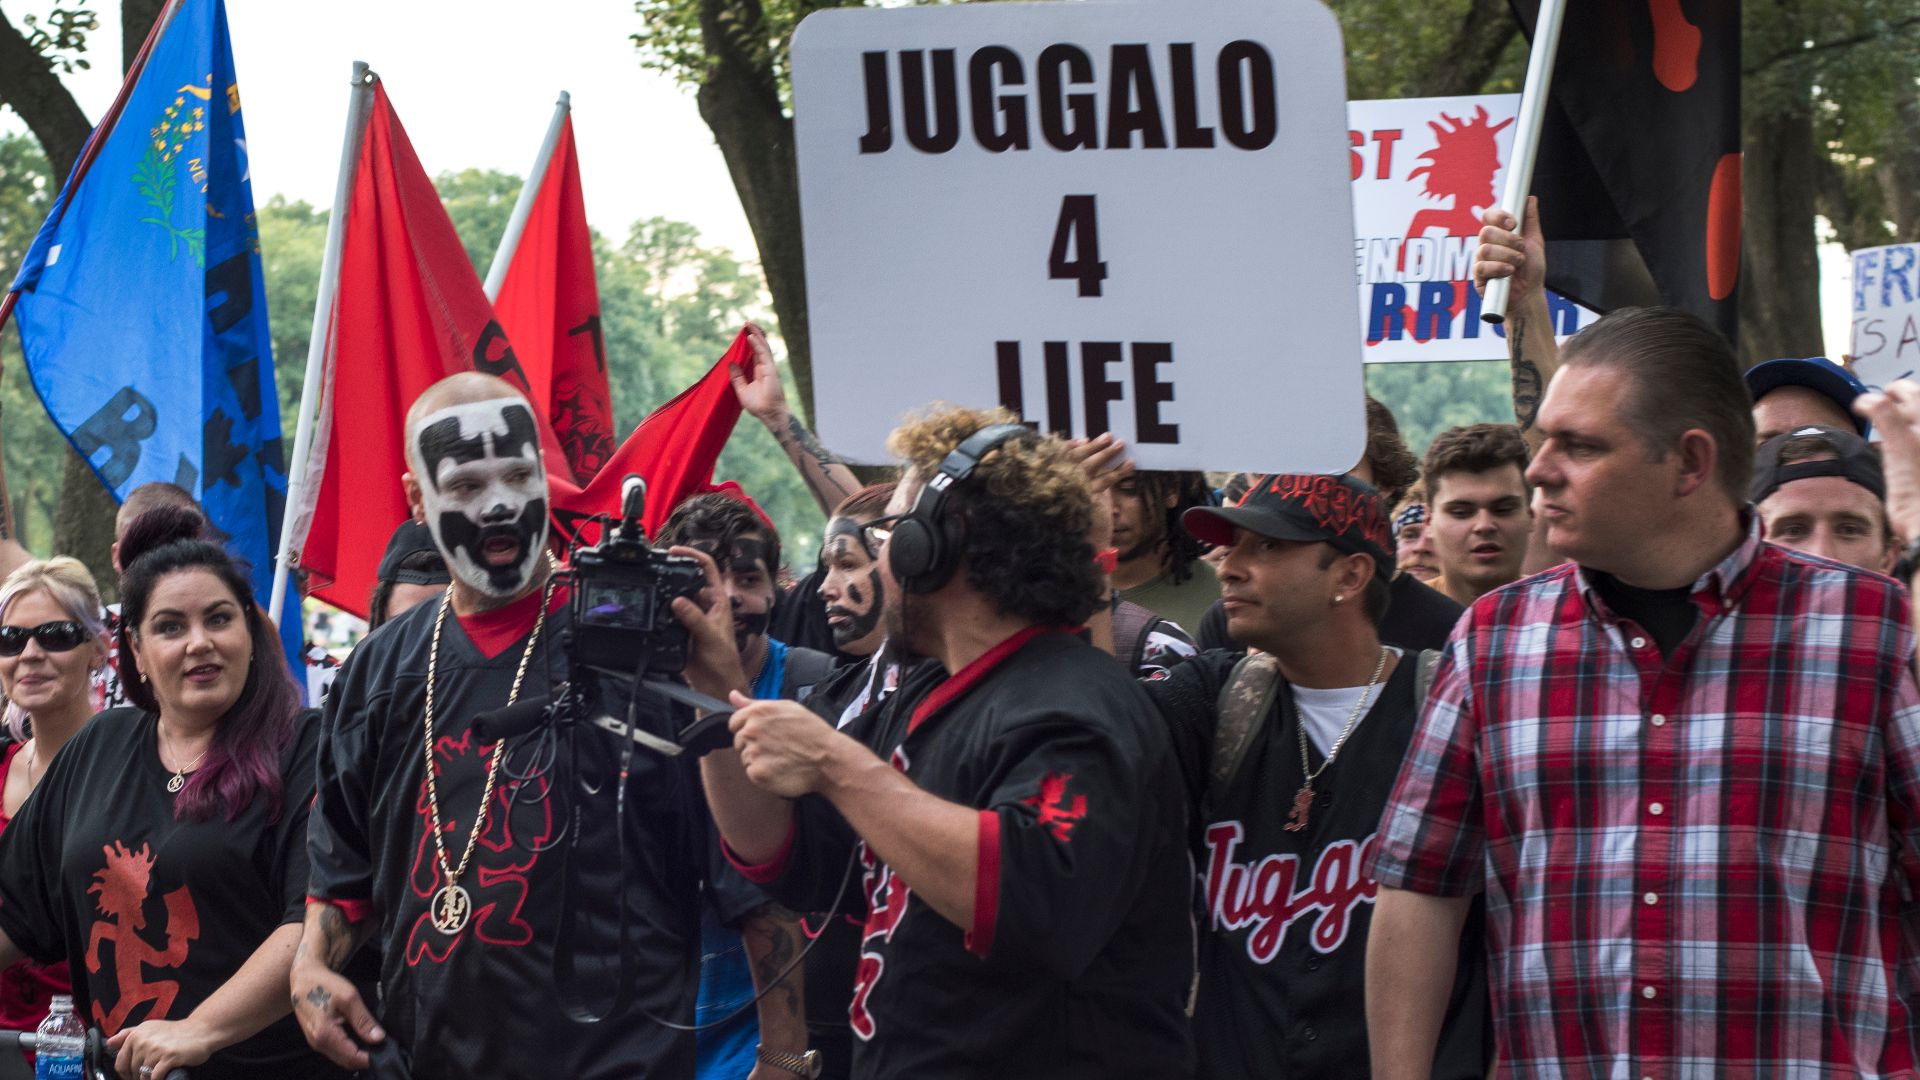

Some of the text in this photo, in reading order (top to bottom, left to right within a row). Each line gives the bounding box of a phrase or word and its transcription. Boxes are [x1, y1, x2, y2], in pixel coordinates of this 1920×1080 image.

[859, 39, 1279, 154] JUGGALO
[1048, 194, 1109, 297] 4
[1854, 247, 1920, 311] FR
[995, 341, 1180, 444] LIFE
